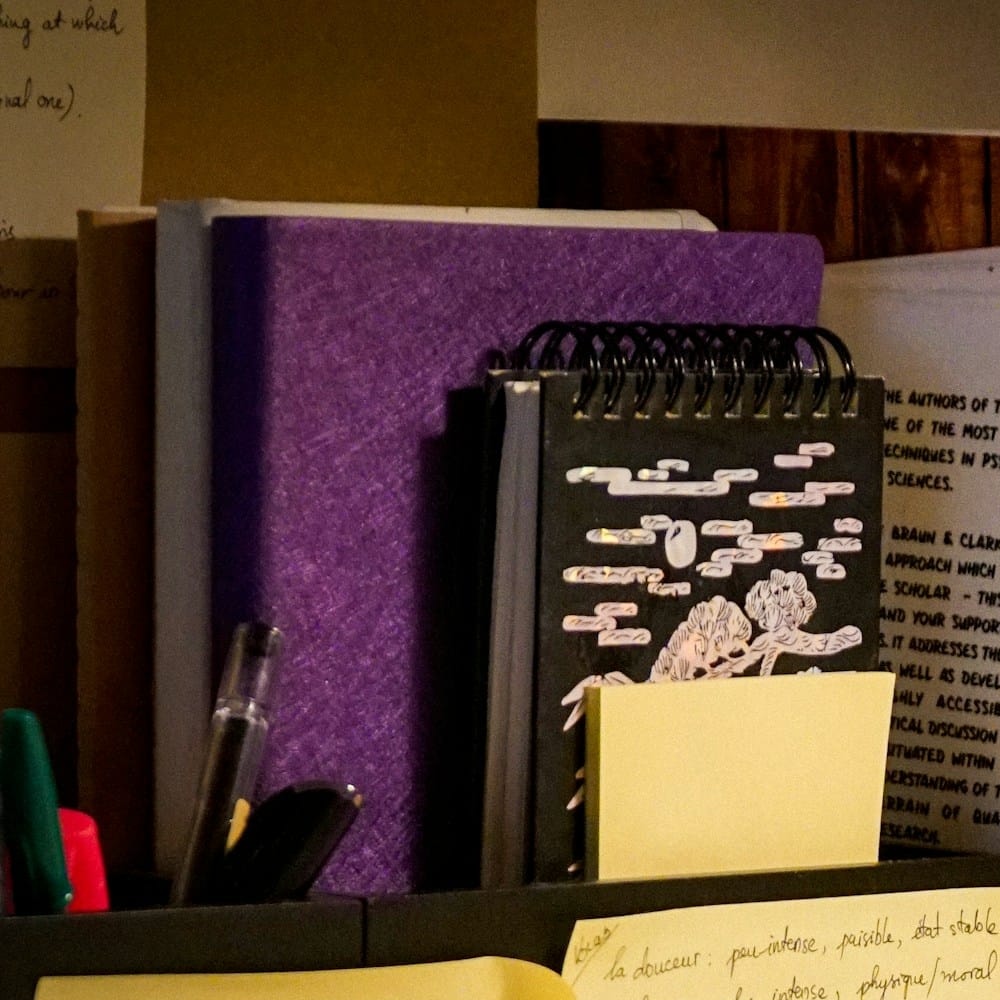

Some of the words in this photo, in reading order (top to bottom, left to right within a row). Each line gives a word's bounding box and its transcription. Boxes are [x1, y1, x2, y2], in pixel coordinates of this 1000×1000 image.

[42, 11, 63, 32] at
[72, 6, 124, 35] which
[909, 390, 966, 411] AUTHORS
[971, 398, 988, 412] OF
[906, 419, 923, 433] OF
[931, 420, 955, 436] THE
[962, 423, 998, 442] MOST
[961, 452, 974, 467] IN
[887, 470, 954, 491] SCIENCES.
[891, 524, 936, 544] BRAUN
[943, 532, 953, 546] &
[885, 552, 952, 574] APPROACH
[958, 561, 996, 579] WHICH
[894, 580, 951, 600] SCHOLAR
[879, 608, 906, 623] AND
[912, 611, 946, 629] YOUR
[892, 635, 904, 649] IT
[908, 636, 978, 659] ADDRESSES
[899, 663, 932, 682] WELL
[939, 667, 955, 684] AS
[928, 720, 998, 744] DISCUSSION
[951, 751, 995, 771] WITHIN
[972, 781, 990, 797] OF
[942, 804, 960, 820] OF
[604, 945, 626, 980] la
[951, 907, 999, 937] stable
